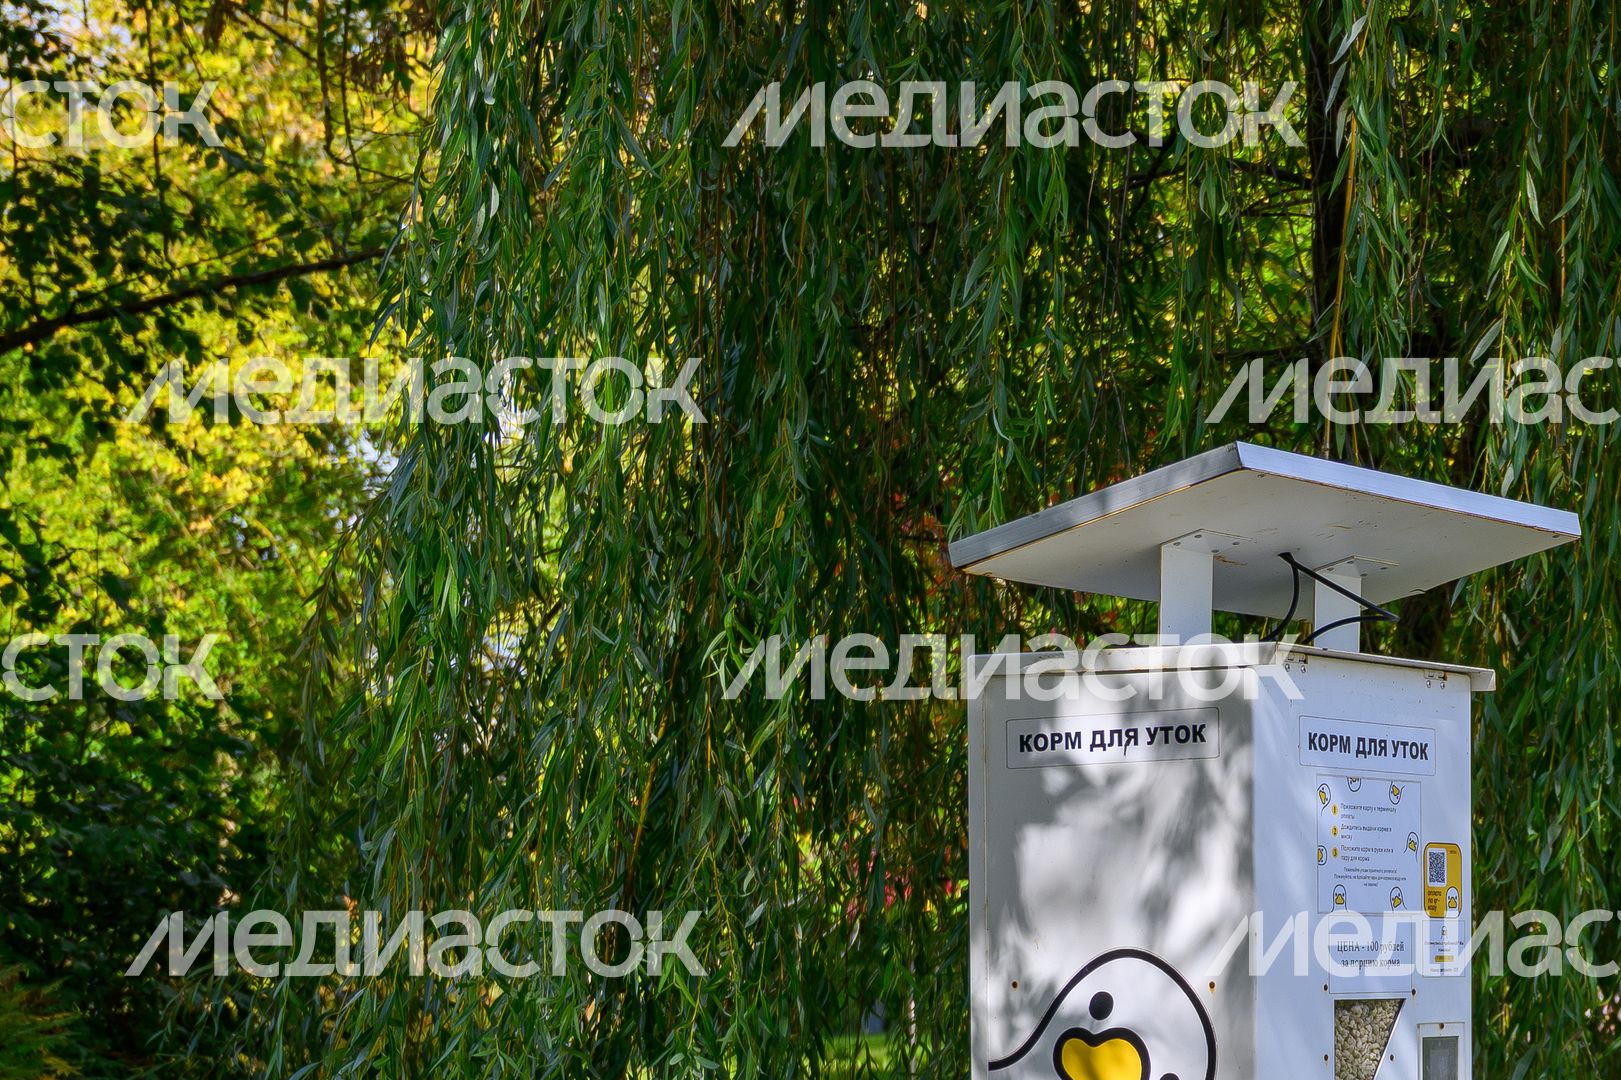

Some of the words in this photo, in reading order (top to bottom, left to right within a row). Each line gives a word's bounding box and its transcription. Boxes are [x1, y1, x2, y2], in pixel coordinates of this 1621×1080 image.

[1019, 731, 1081, 752] КОРМ
[1090, 728, 1138, 751] ДЛЯ
[1145, 724, 1206, 745] УТОК
[1308, 732, 1350, 754] КОРМ
[1355, 737, 1387, 759] ДЛЯ
[1391, 739, 1429, 760] УТОК
[1337, 941, 1360, 954] ЦЕНА
[1367, 941, 1379, 952] 100
